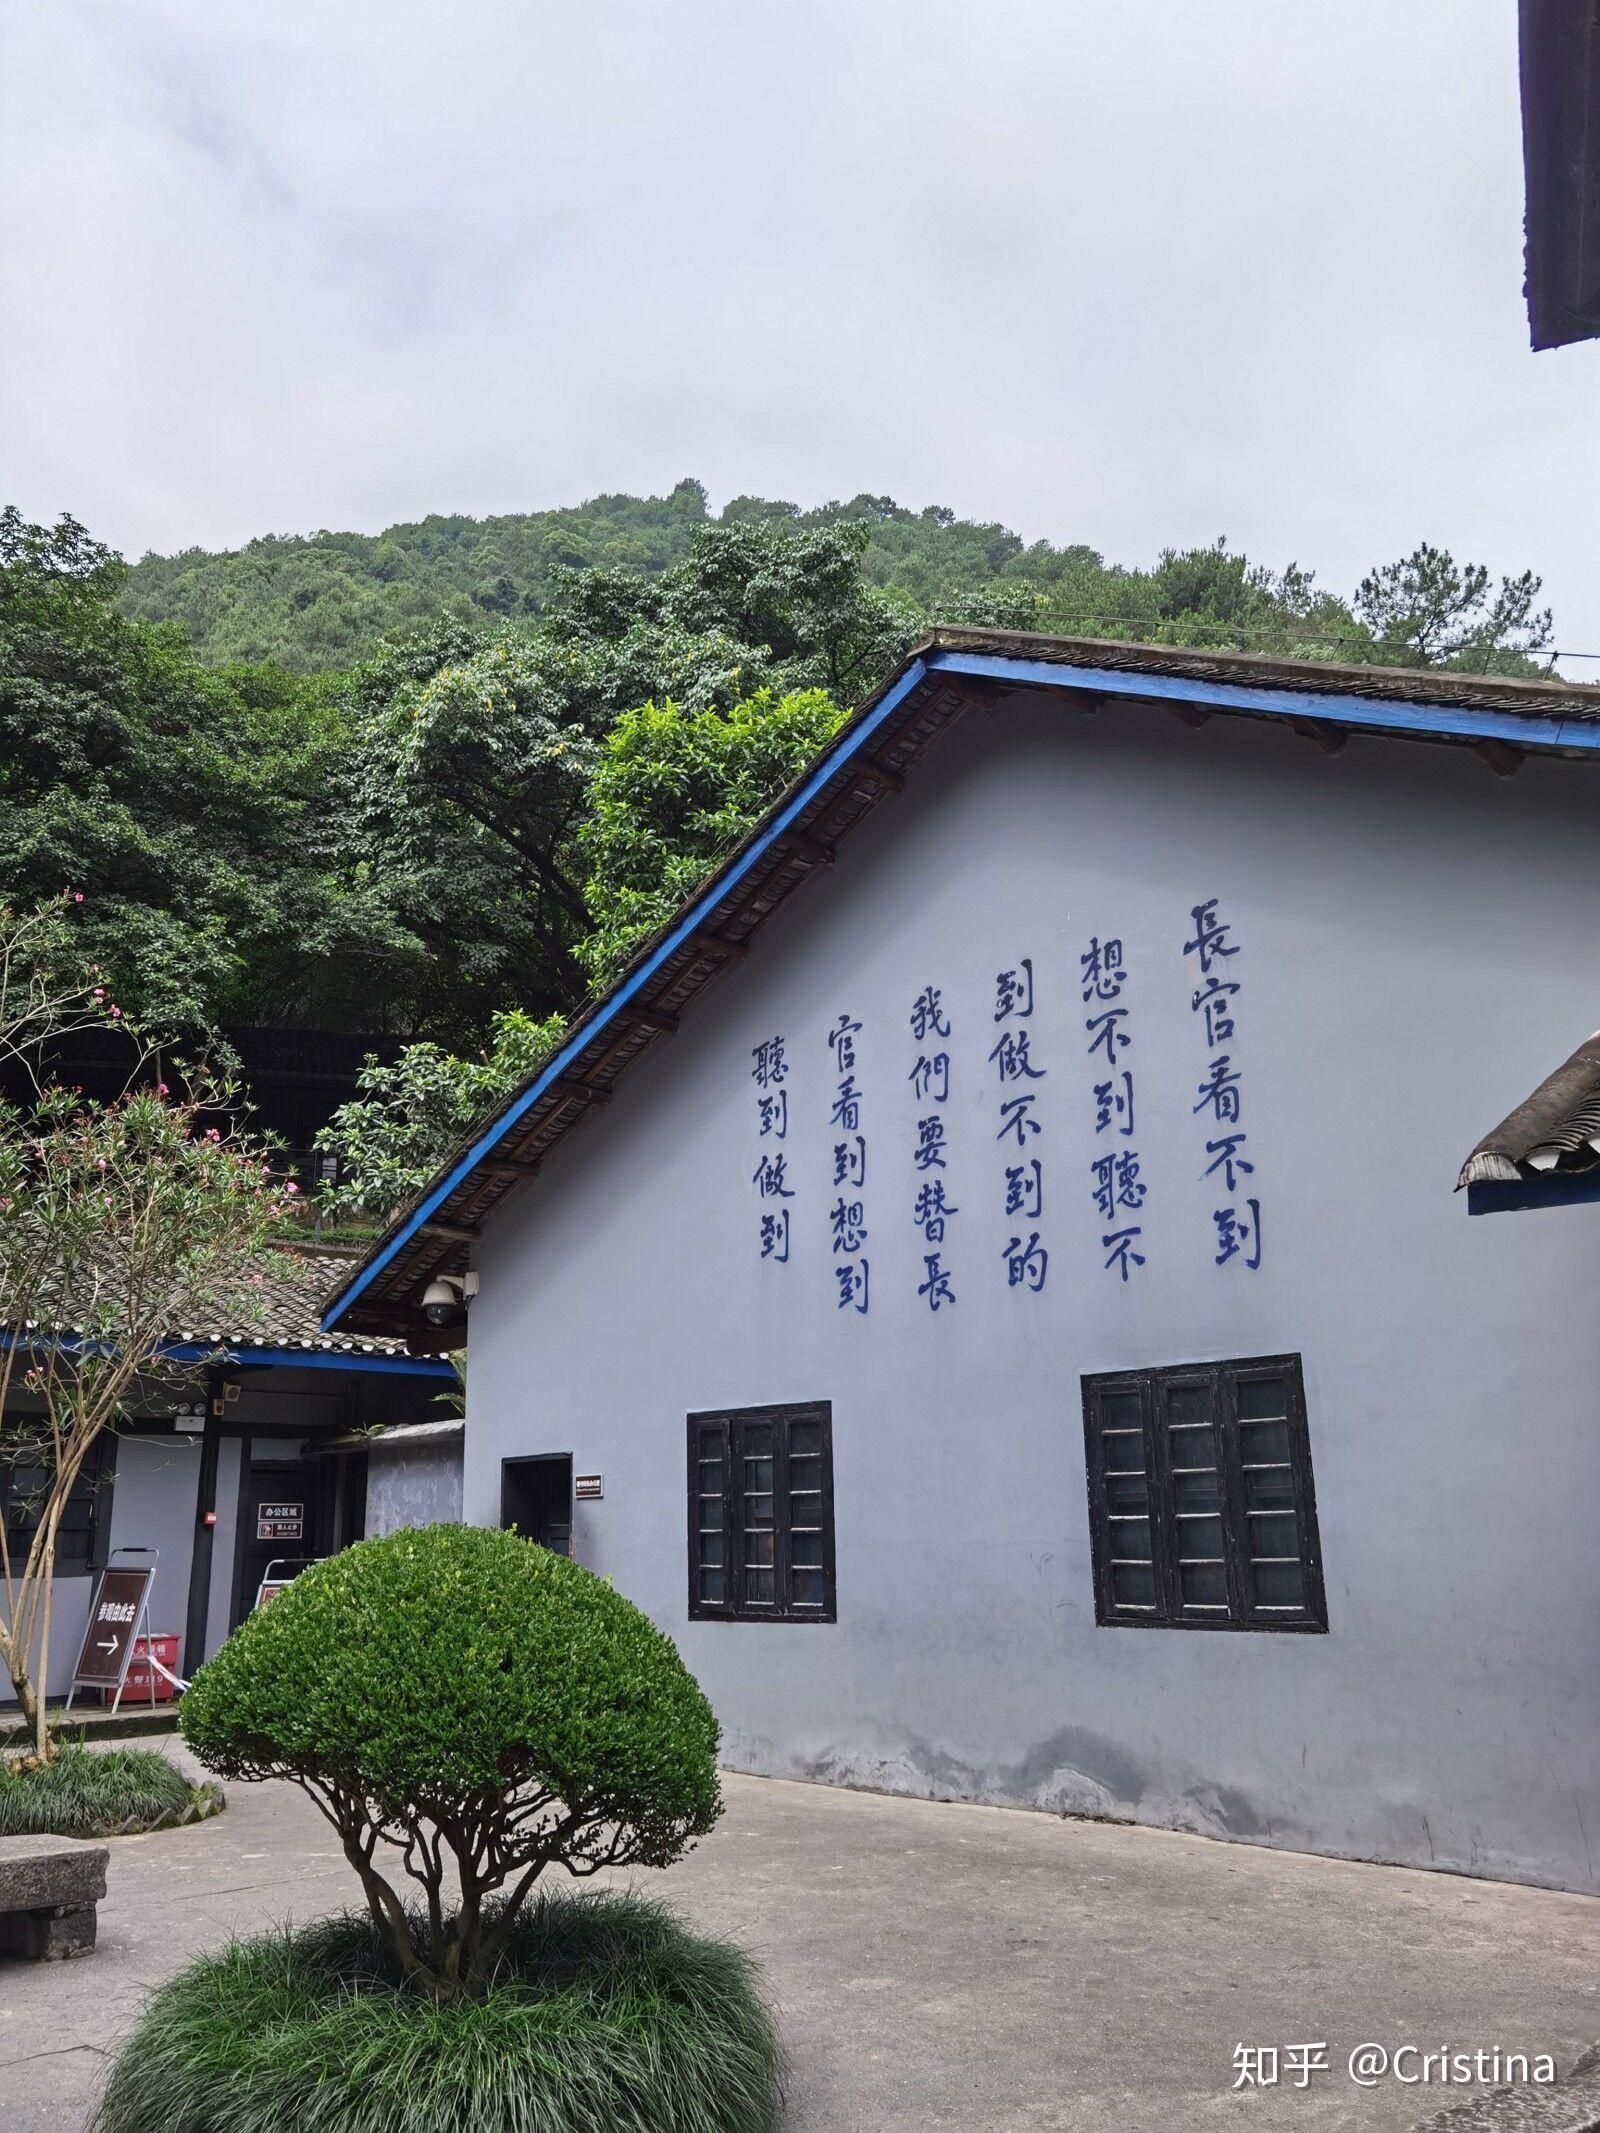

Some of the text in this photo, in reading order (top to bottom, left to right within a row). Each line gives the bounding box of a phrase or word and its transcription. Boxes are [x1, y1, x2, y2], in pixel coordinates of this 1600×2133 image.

[752, 1035, 795, 1263] 聽到做到
[829, 1015, 868, 1314] 官看到想到
[908, 986, 958, 1311] 我們要替長
[989, 959, 1048, 1292] 到做不到的
[1081, 937, 1147, 1282] 想不到聽不
[1183, 899, 1261, 1270] 長官看不到
[265, 1507, 298, 1517] 办公区域
